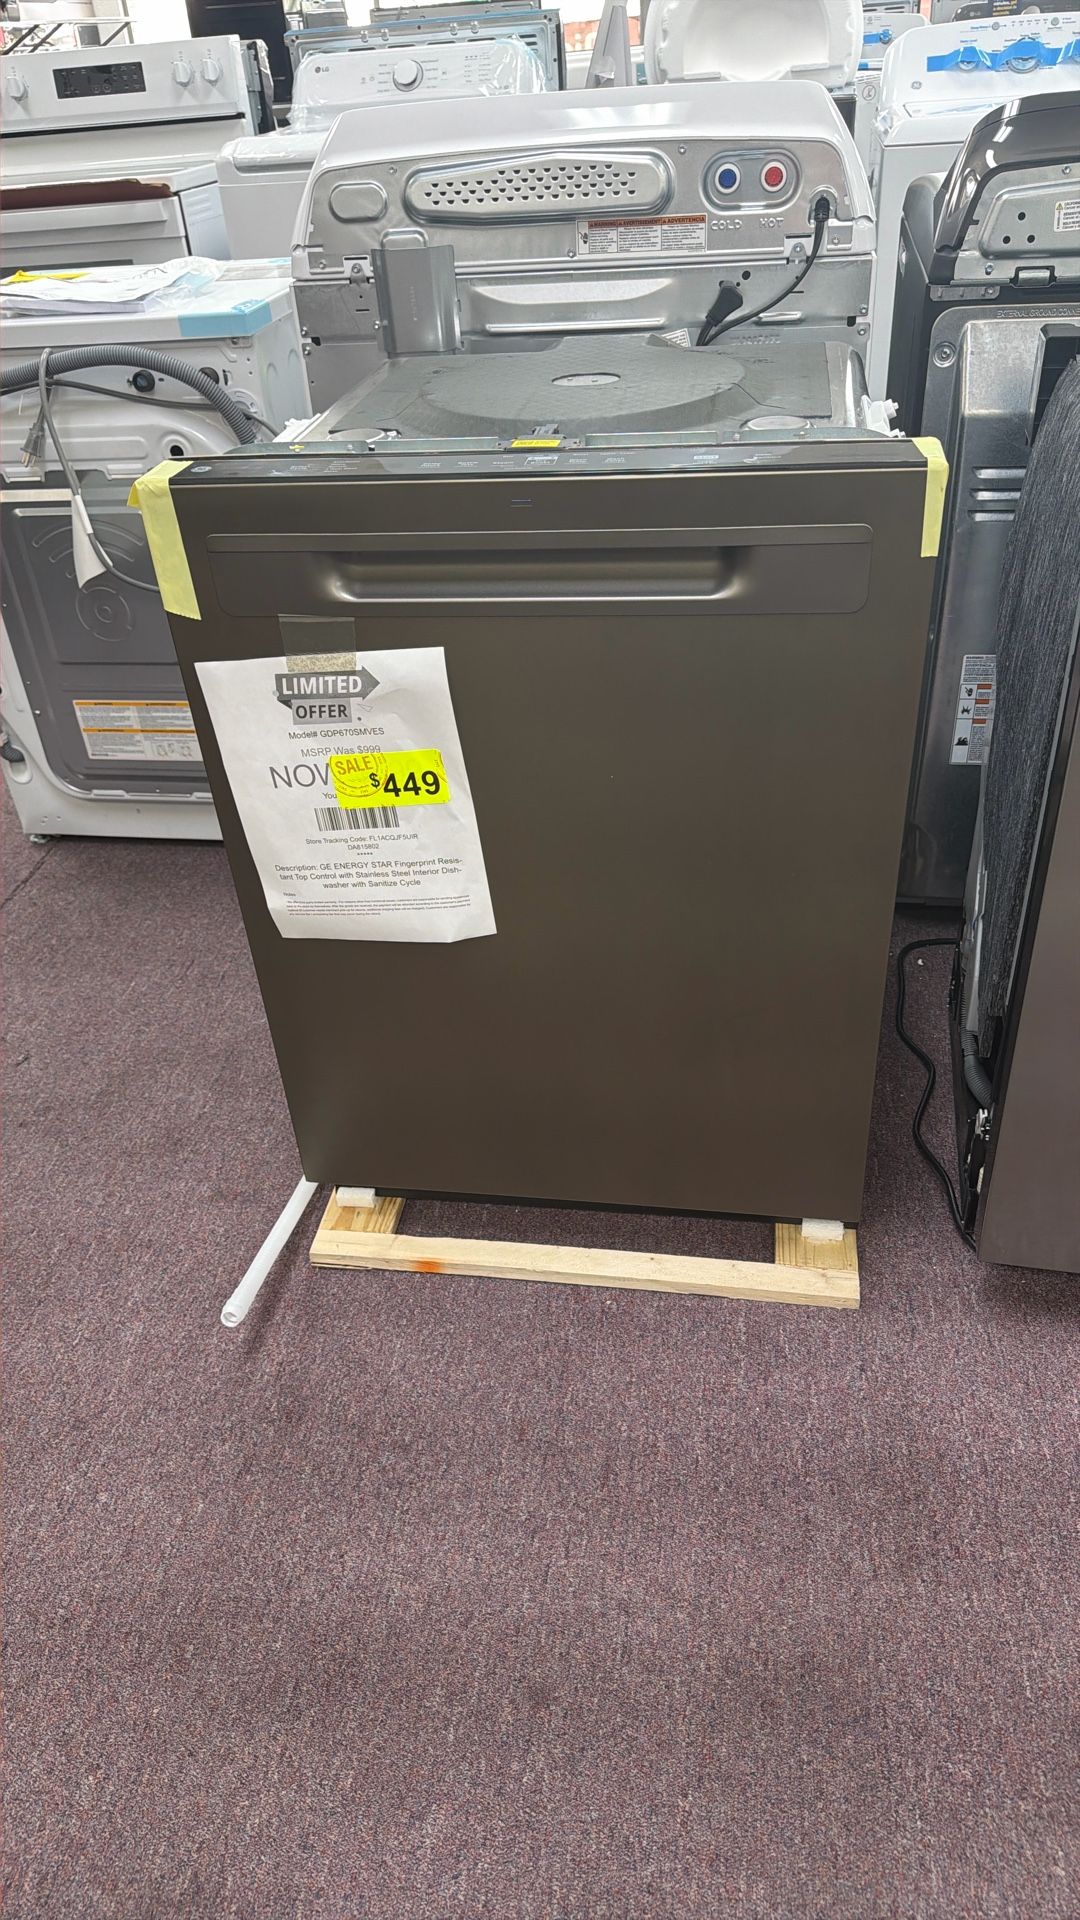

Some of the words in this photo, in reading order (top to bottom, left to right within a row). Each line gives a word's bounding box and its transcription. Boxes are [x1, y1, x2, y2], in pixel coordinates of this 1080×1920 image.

[711, 219, 743, 231] COLD
[760, 217, 784, 229] HOT
[282, 675, 363, 695] LIMITED
[295, 704, 348, 719] OFFER
[288, 730, 318, 740] Model#
[319, 728, 385, 738] GDP670SMVES
[301, 747, 332, 758] MSRP
[334, 746, 355, 755] Was
[358, 744, 381, 755] $999
[335, 756, 374, 776] SALE
[369, 770, 441, 798] $449
[323, 836, 350, 845] Tracking
[275, 864, 319, 873] Description:
[319, 863, 332, 871] GE
[334, 862, 369, 870] ENERGY
[371, 861, 392, 869] STAR
[394, 858, 436, 868] Fingerprint
[438, 857, 463, 865] Resis-
[295, 872, 309, 881] Top
[310, 871, 336, 879] Control
[338, 870, 353, 878] with
[355, 869, 389, 878] Stainless
[391, 869, 411, 877] Steel
[412, 867, 440, 876] Interior
[442, 866, 462, 874] Dish-
[322, 881, 349, 889] washer
[350, 880, 367, 888] with
[368, 879, 398, 887] Sanitize
[399, 878, 421, 887] Cycle
